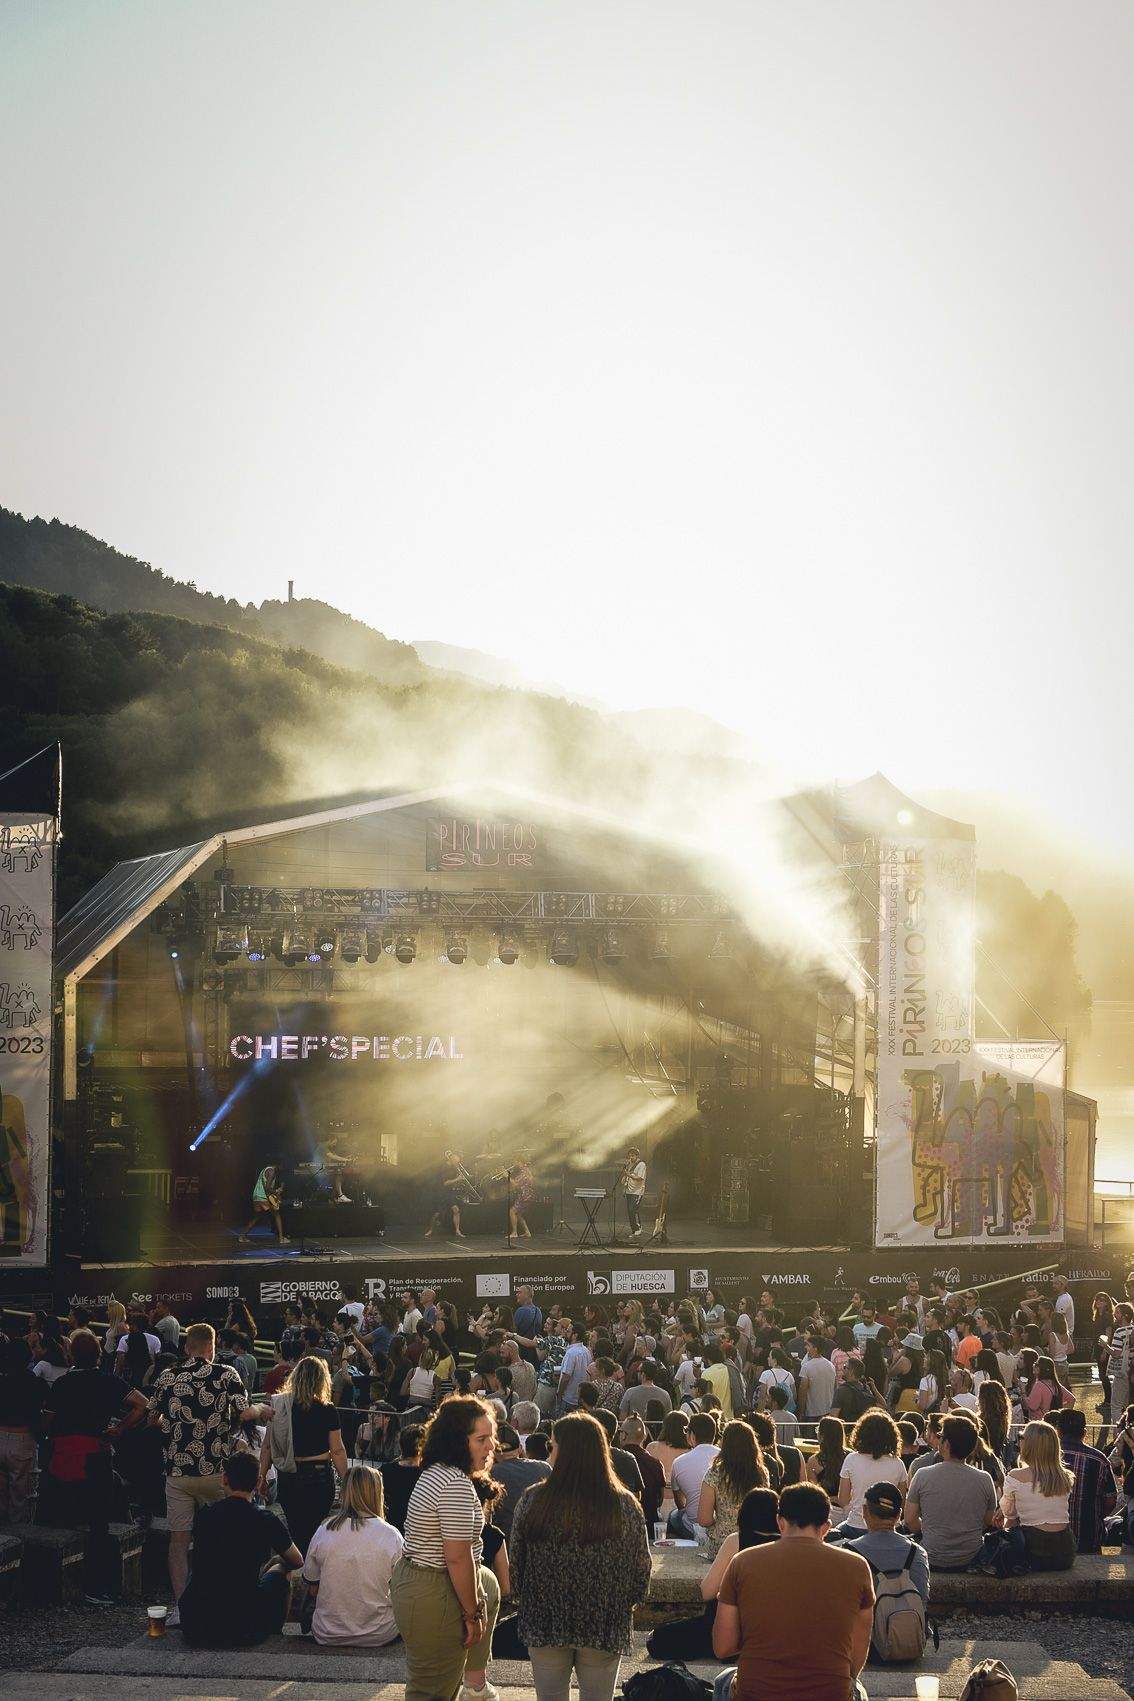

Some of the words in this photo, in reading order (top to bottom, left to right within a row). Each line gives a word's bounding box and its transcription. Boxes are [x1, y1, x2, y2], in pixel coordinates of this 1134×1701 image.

[440, 818, 537, 850] PIRINEOS
[441, 852, 535, 866] SUR
[888, 924, 898, 995] INTERNACIONAL
[888, 997, 897, 1036] FESTIVAL
[0, 1037, 44, 1053] 2023
[931, 1039, 971, 1054] 2023
[616, 1271, 667, 1281] DIPUTACIÓN
[771, 1274, 812, 1284] AMBAR
[869, 1275, 902, 1284] embou
[282, 1280, 340, 1291] GOBIERNO
[545, 1284, 575, 1292] Europea
[617, 1283, 628, 1291] DE
[630, 1282, 666, 1291] HUESCA
[131, 1292, 153, 1303] See
[154, 1292, 193, 1302] TICKETS
[282, 1292, 297, 1302] DE
